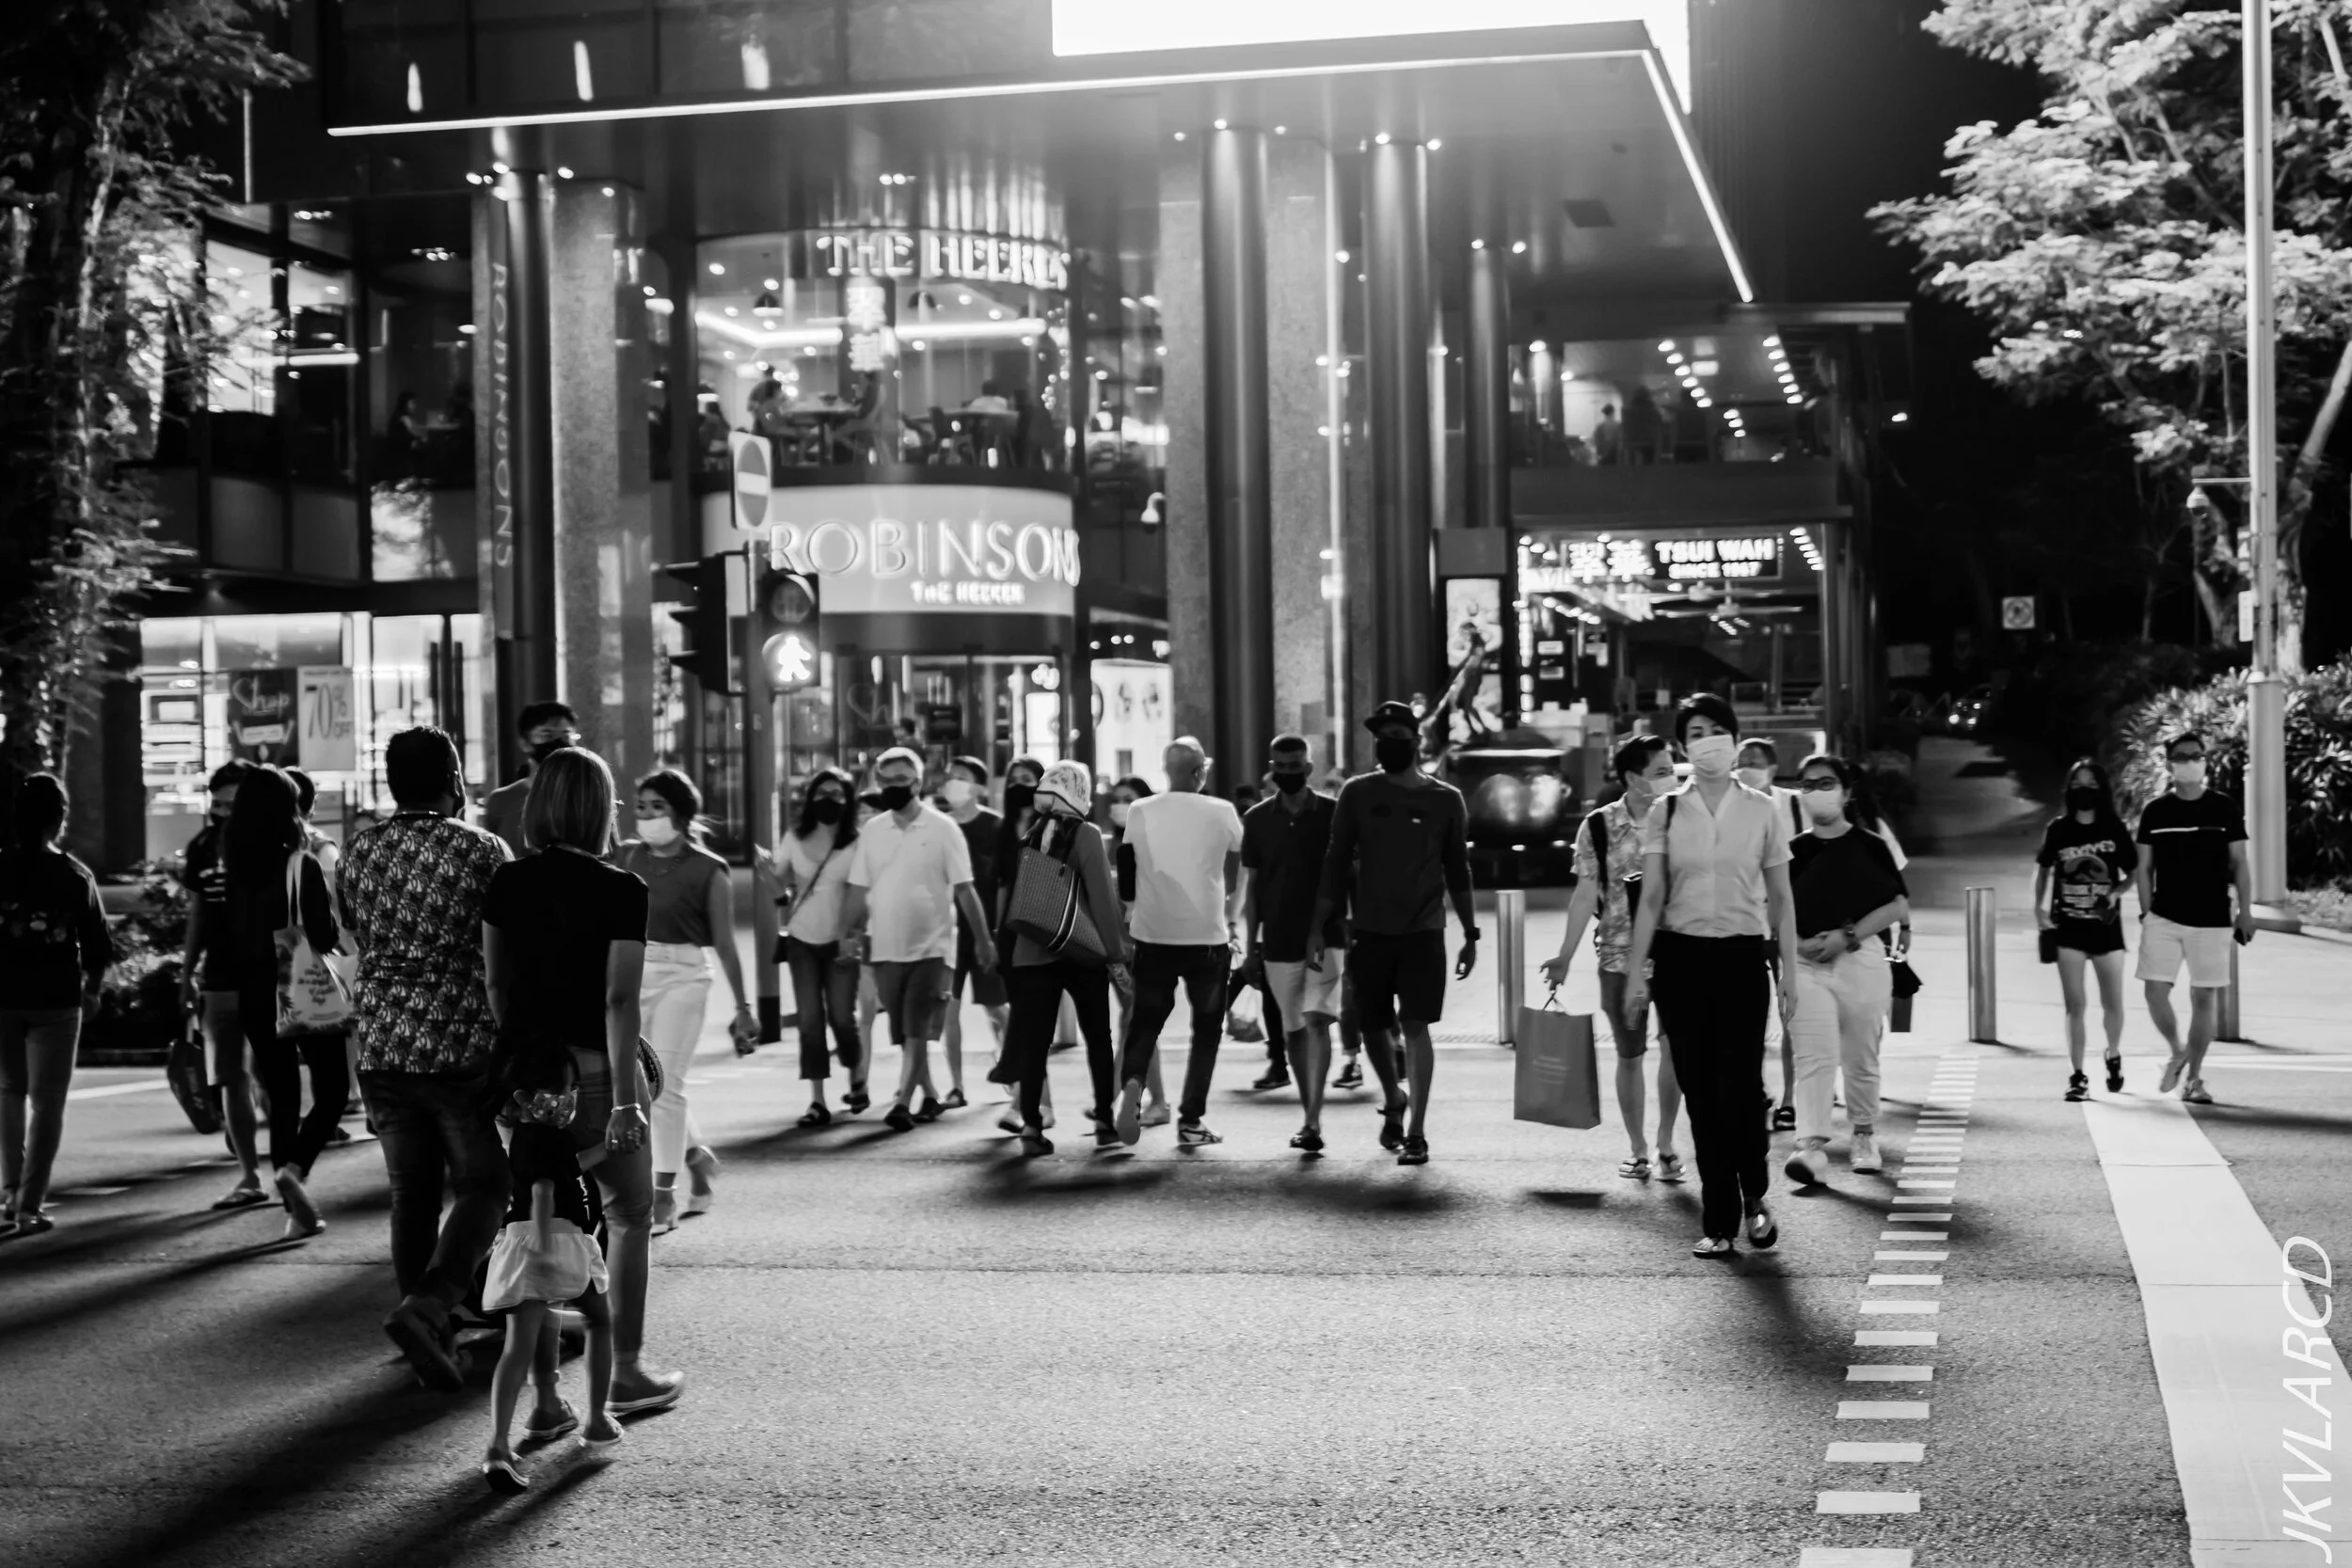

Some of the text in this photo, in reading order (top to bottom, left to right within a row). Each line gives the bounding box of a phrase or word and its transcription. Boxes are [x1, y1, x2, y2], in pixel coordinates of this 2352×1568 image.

[817, 235, 914, 277] THE
[1655, 538, 1775, 563] TSUI WAH
[1668, 562, 1722, 579] SINCE
[910, 579, 953, 604] THE
